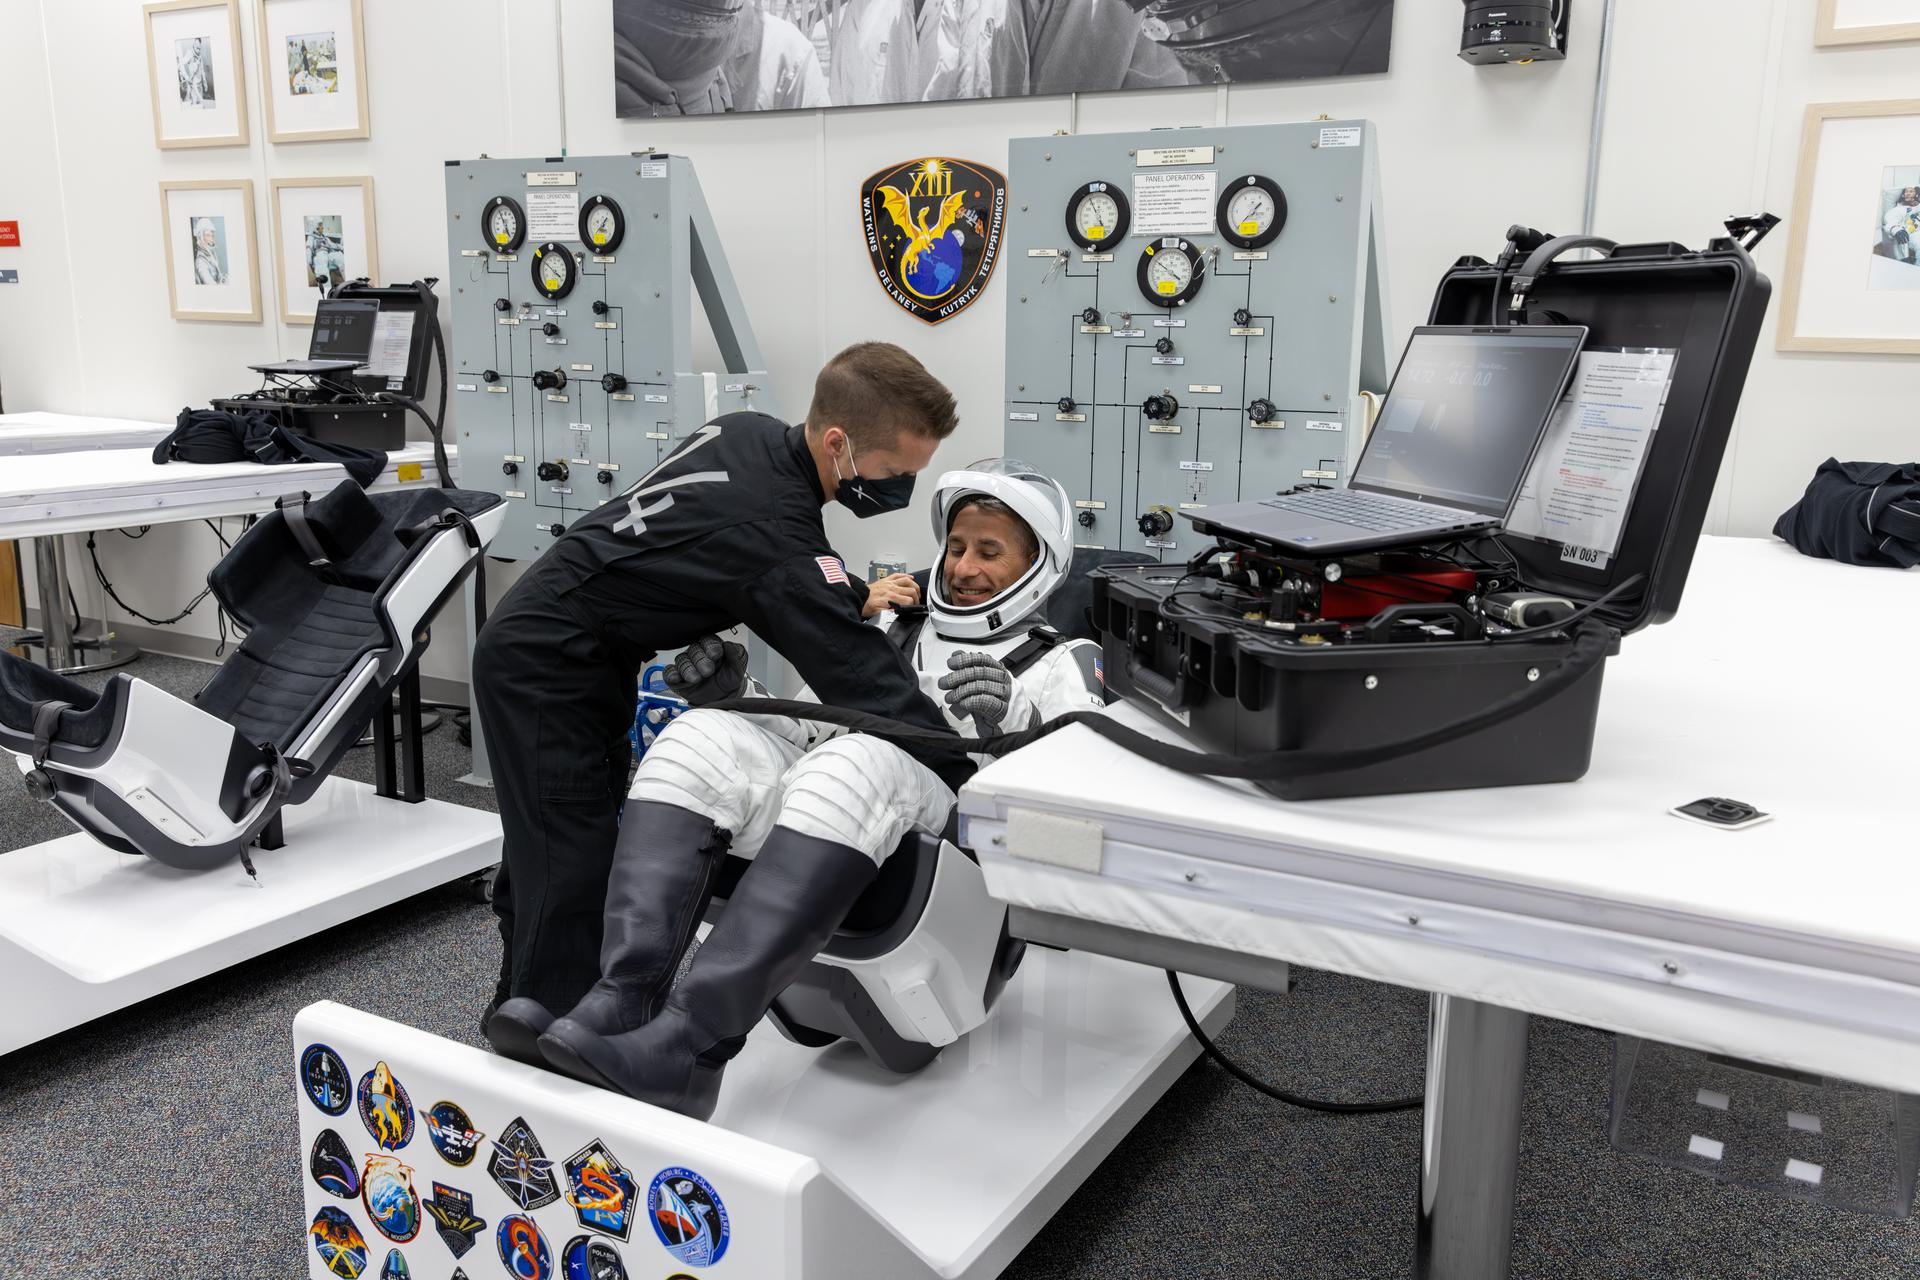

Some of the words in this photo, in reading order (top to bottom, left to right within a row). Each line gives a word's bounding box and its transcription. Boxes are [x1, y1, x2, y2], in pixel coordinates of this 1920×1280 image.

[908, 171, 953, 198] XIII
[1145, 175, 1164, 183] PANEL
[1166, 173, 1205, 182] OPERATIONS
[862, 197, 878, 253] WATKINS
[978, 187, 1005, 278] ТЕТЕРЯТНИКОВ
[878, 269, 918, 313] DELANEY
[939, 285, 978, 317] KUTRYK
[1563, 545, 1578, 559] SN
[1579, 548, 1598, 563] 003
